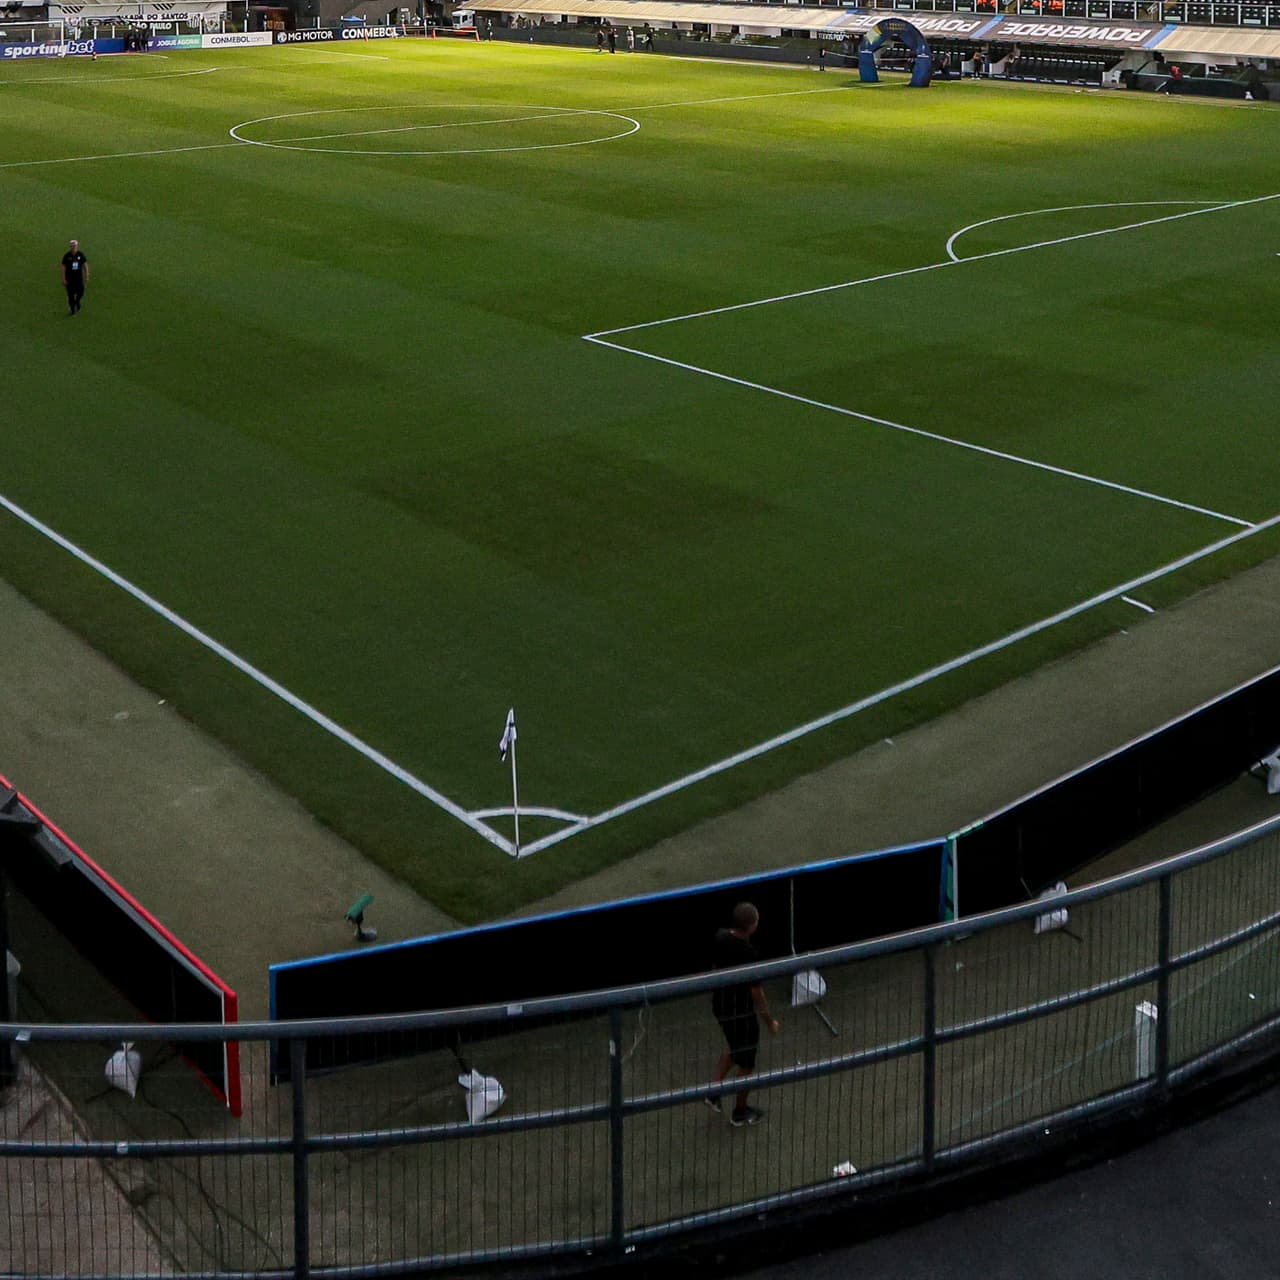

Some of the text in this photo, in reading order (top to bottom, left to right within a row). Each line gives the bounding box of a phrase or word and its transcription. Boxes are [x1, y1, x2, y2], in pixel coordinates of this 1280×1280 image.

[342, 27, 398, 39] CONMEBOL
[849, 14, 981, 33] POWEDE
[998, 21, 1152, 42] POWERADE
[288, 32, 301, 40] MG
[303, 31, 333, 40] MOTOR
[4, 39, 94, 58] sportingbet
